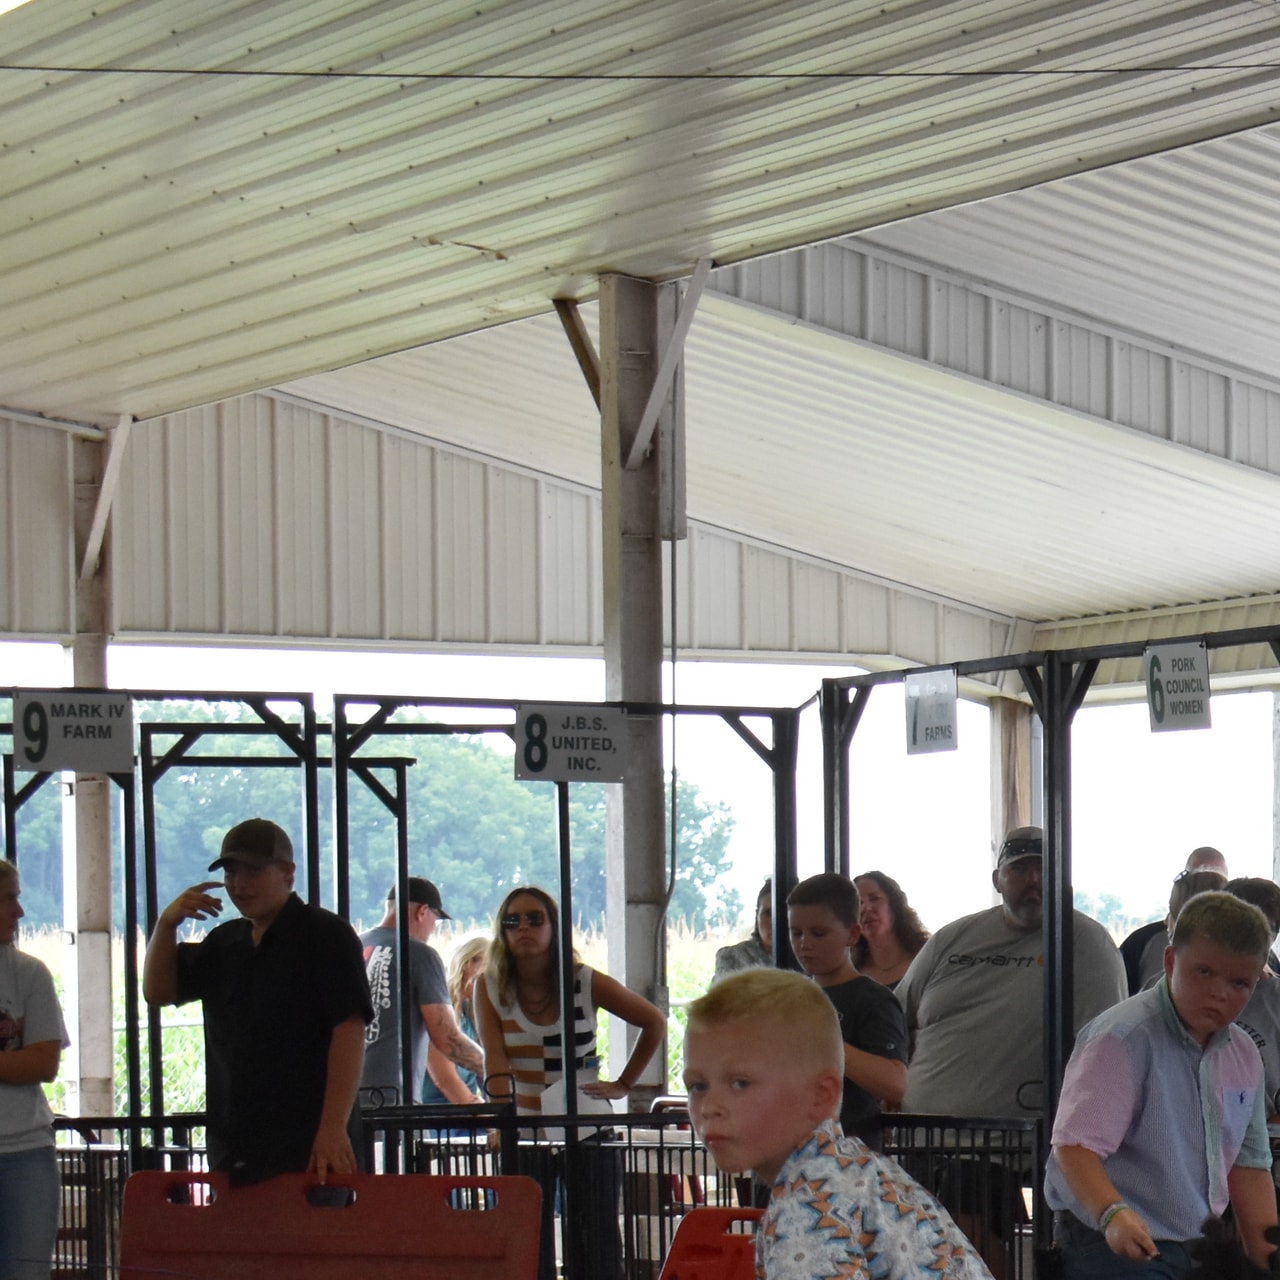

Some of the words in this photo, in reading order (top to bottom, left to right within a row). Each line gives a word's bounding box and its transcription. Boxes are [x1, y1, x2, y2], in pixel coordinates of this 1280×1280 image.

[1171, 657, 1196, 672] PORK
[1150, 655, 1164, 724] 6
[1166, 677, 1205, 695] COUNCIL
[50, 703, 102, 718] MARK
[108, 704, 124, 718] IV
[1169, 700, 1203, 715] WOMEN
[561, 716, 607, 731] J.B.S.
[23, 701, 48, 764] 9
[63, 725, 112, 739] FARM
[925, 725, 952, 741] FARMS
[524, 713, 548, 773] 8
[552, 736, 617, 753] UNITED,
[567, 757, 601, 771] INC.
